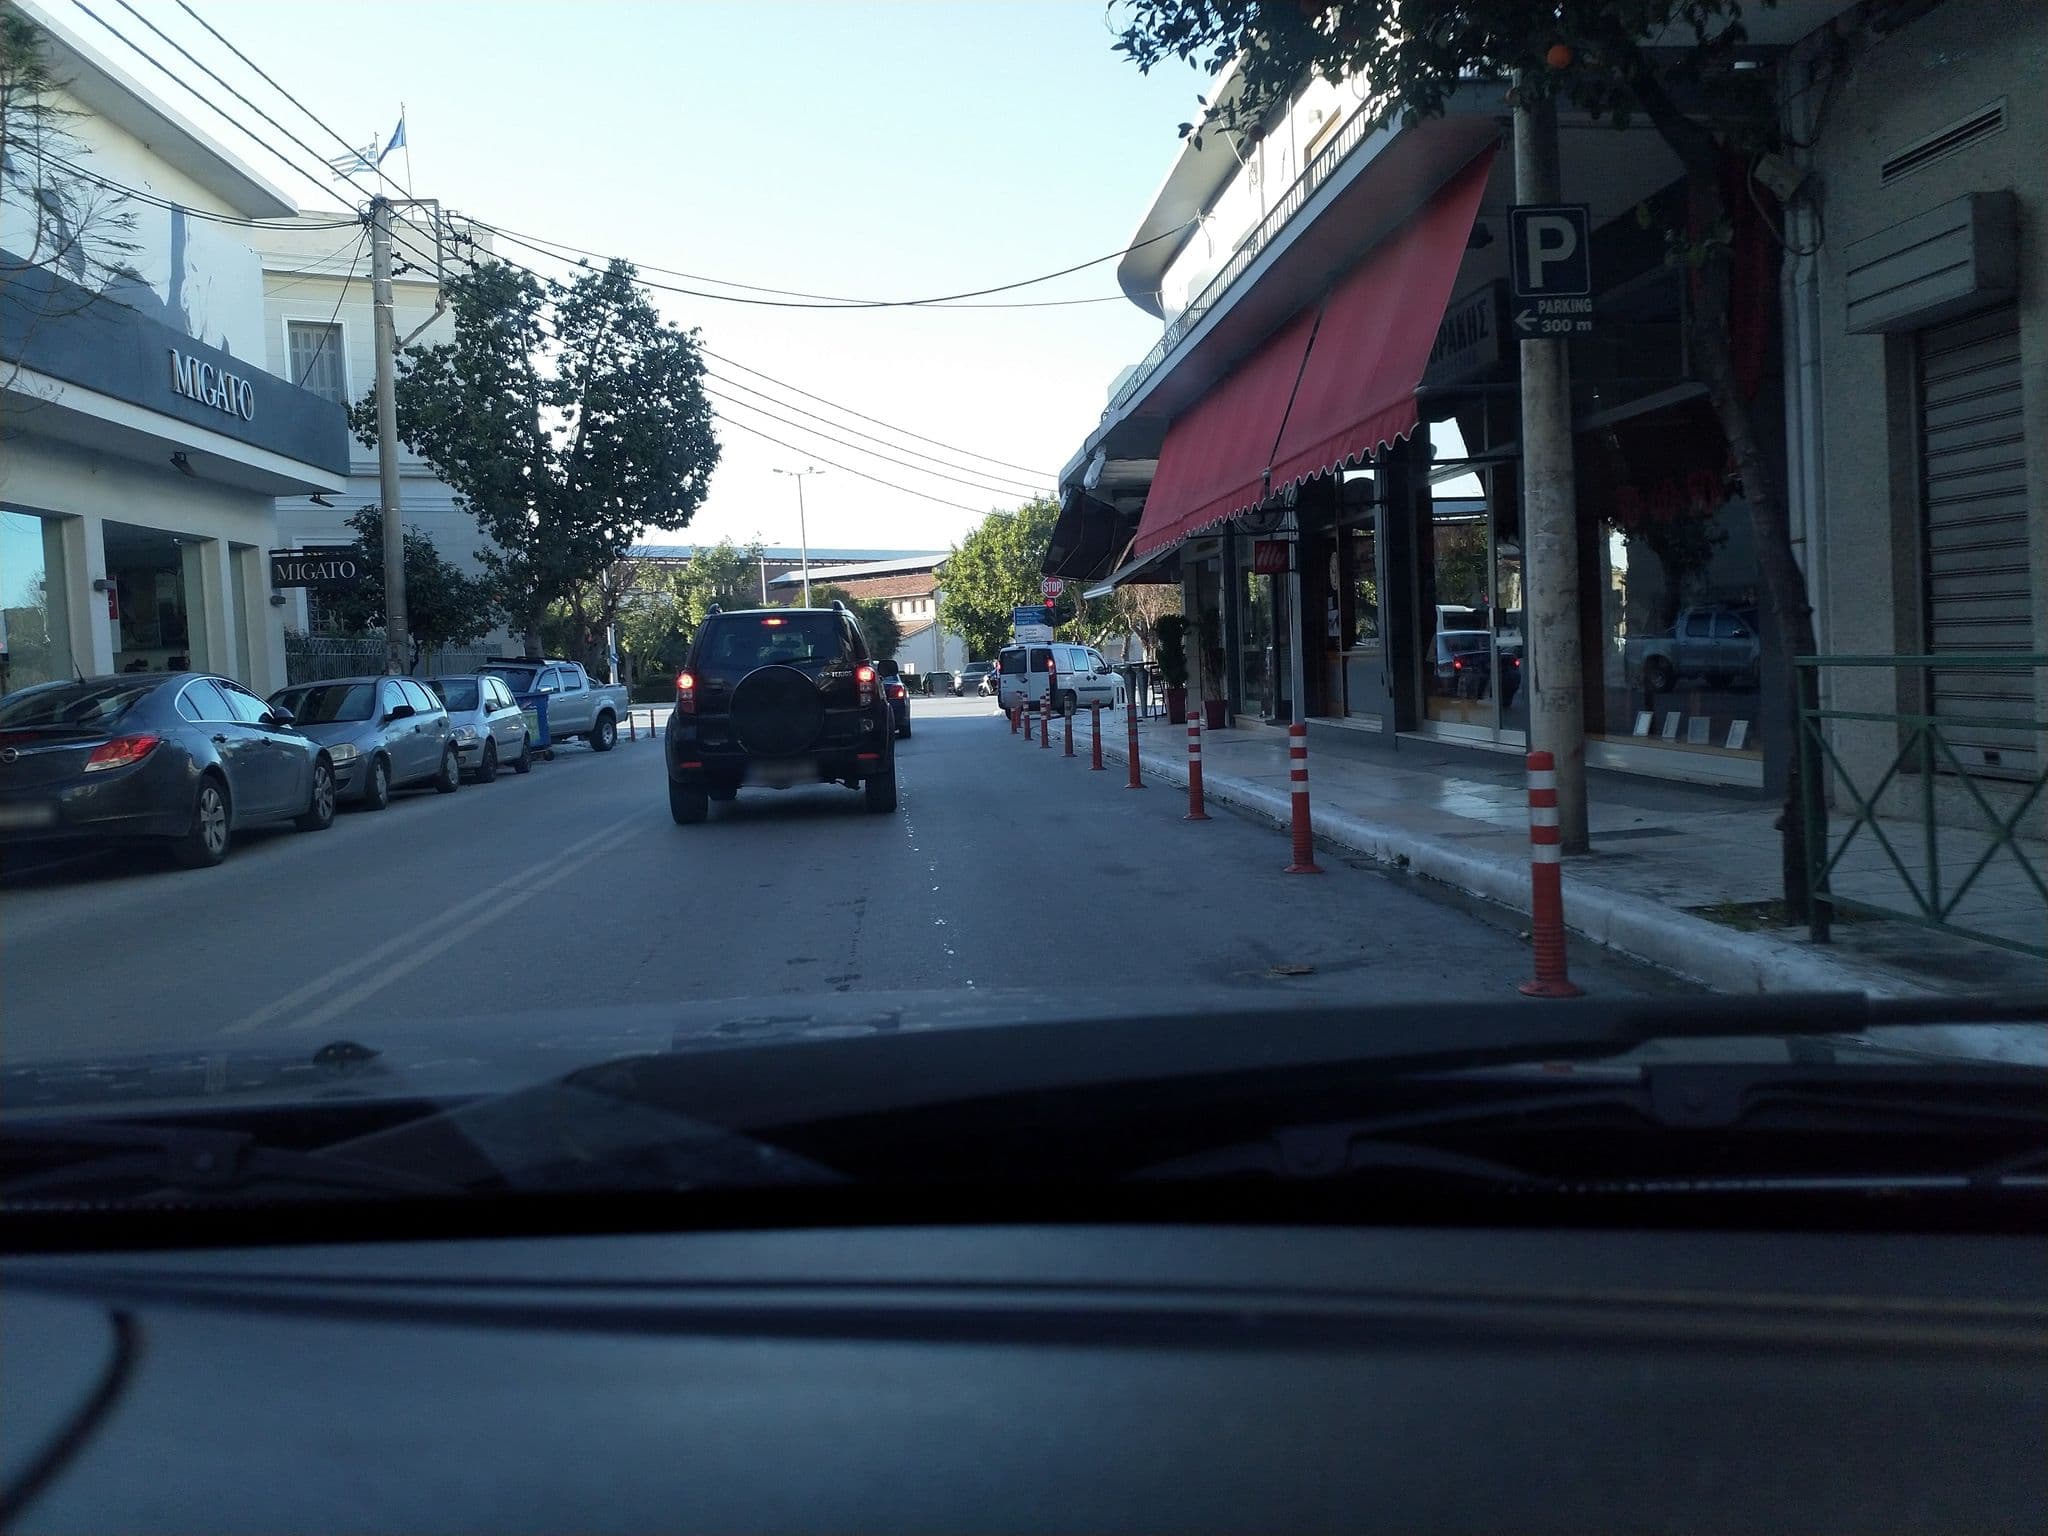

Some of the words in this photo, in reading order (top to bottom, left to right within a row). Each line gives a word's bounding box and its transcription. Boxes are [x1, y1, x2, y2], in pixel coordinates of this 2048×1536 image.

[1526, 215, 1577, 289] P
[1537, 297, 1593, 315] PARKING
[1541, 318, 1573, 334] 300
[1576, 320, 1593, 332] m
[171, 348, 255, 422] MIGATO
[276, 560, 356, 581] MIGATO
[1043, 581, 1062, 593] STOP
